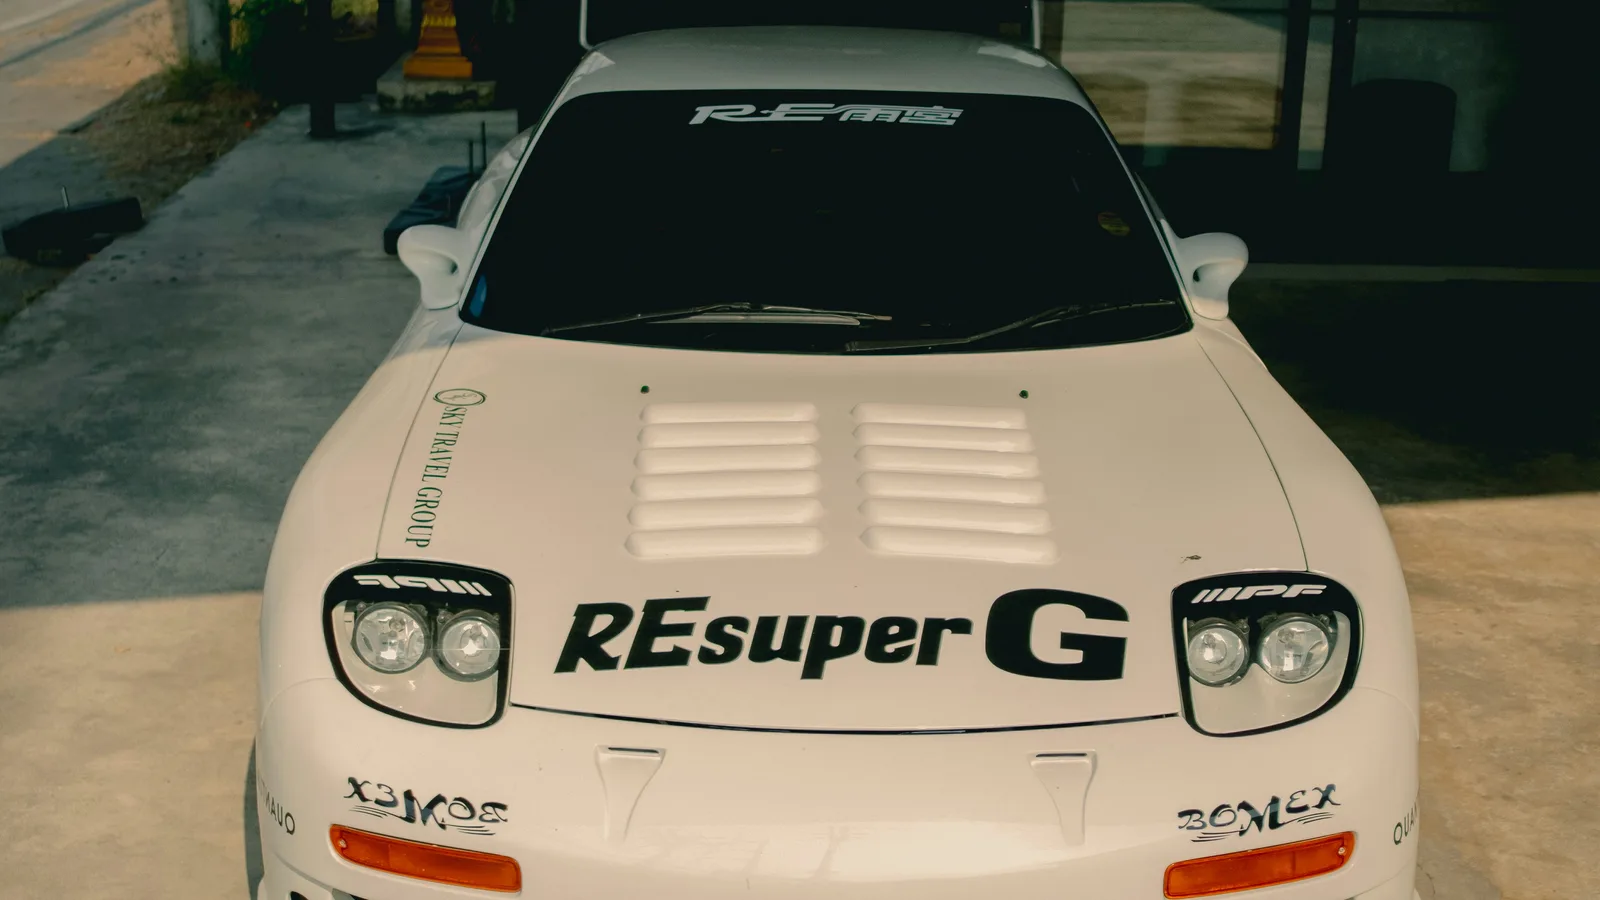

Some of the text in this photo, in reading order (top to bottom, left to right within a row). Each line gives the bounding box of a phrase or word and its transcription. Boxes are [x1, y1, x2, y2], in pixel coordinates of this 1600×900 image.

[439, 406, 468, 428] SKY
[421, 431, 460, 482] TRAVEL
[405, 486, 443, 548] GROUP
[1177, 784, 1341, 842] BOMEX
